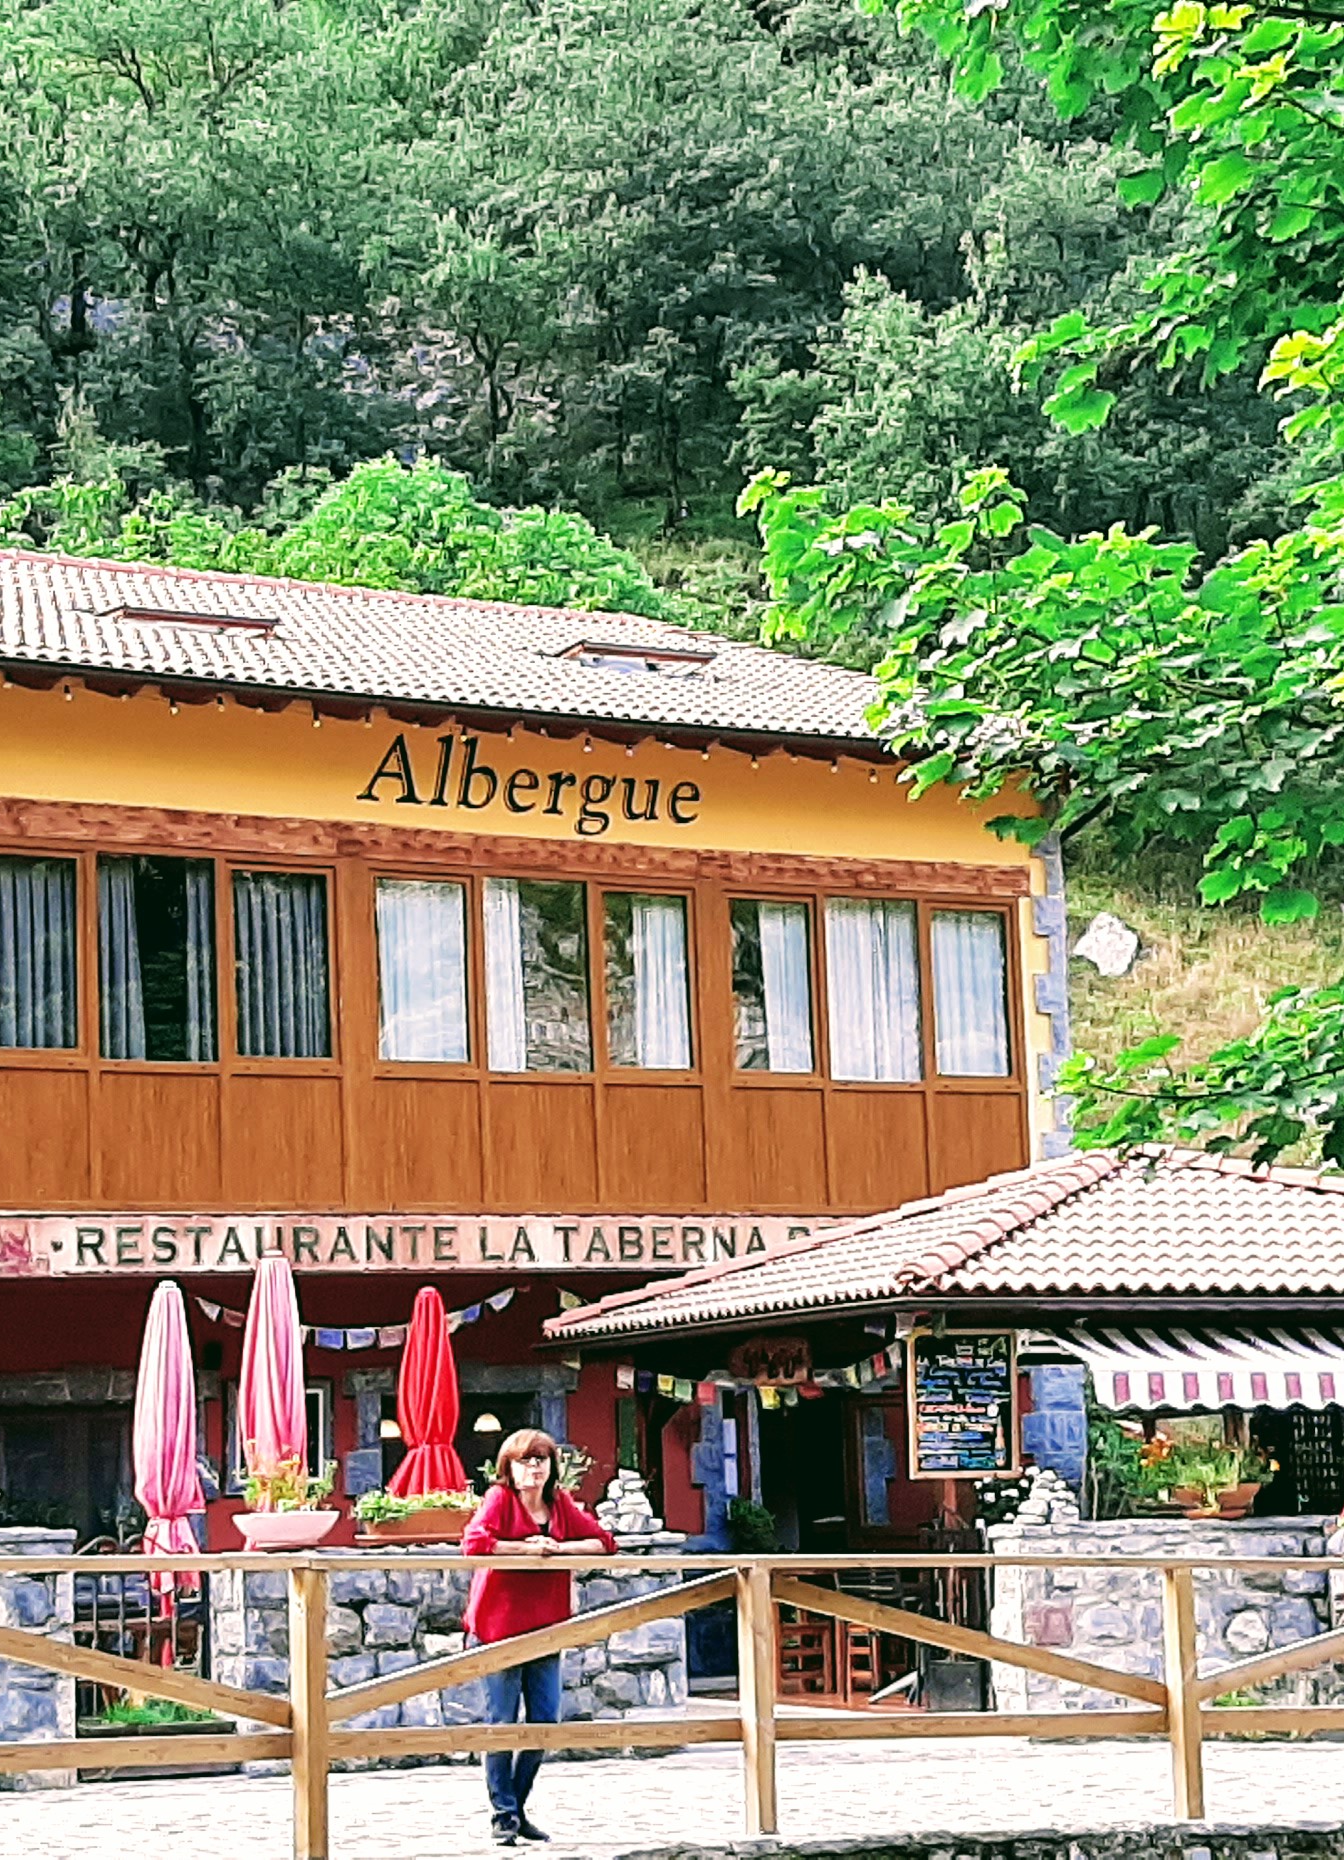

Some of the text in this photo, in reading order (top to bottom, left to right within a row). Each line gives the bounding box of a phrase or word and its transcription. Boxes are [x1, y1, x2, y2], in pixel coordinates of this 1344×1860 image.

[356, 733, 702, 836] Albergue
[75, 1225, 766, 1267] RESTAURANTE LA TABERNA
